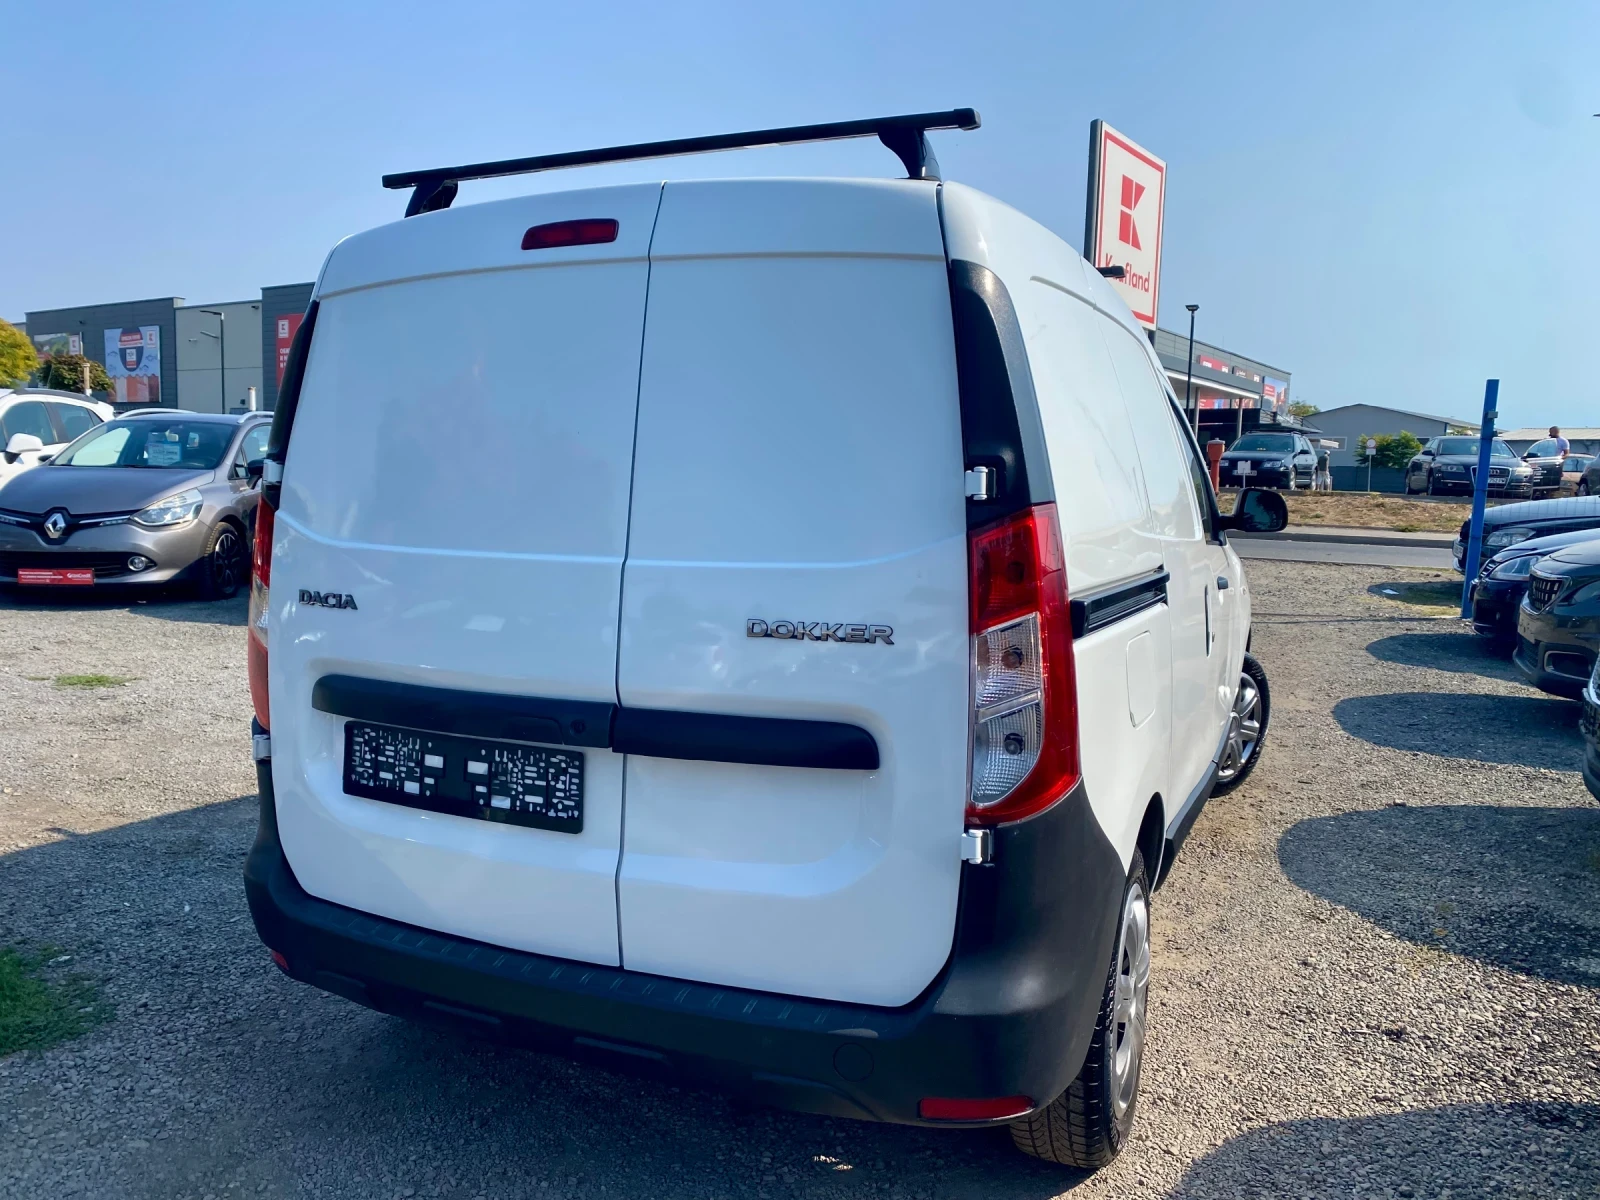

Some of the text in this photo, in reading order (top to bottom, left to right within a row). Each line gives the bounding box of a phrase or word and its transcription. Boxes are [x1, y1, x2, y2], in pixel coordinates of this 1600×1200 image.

[1105, 252, 1151, 293] Kfland
[299, 589, 358, 610] DACIA
[746, 618, 895, 645] DOKKER
